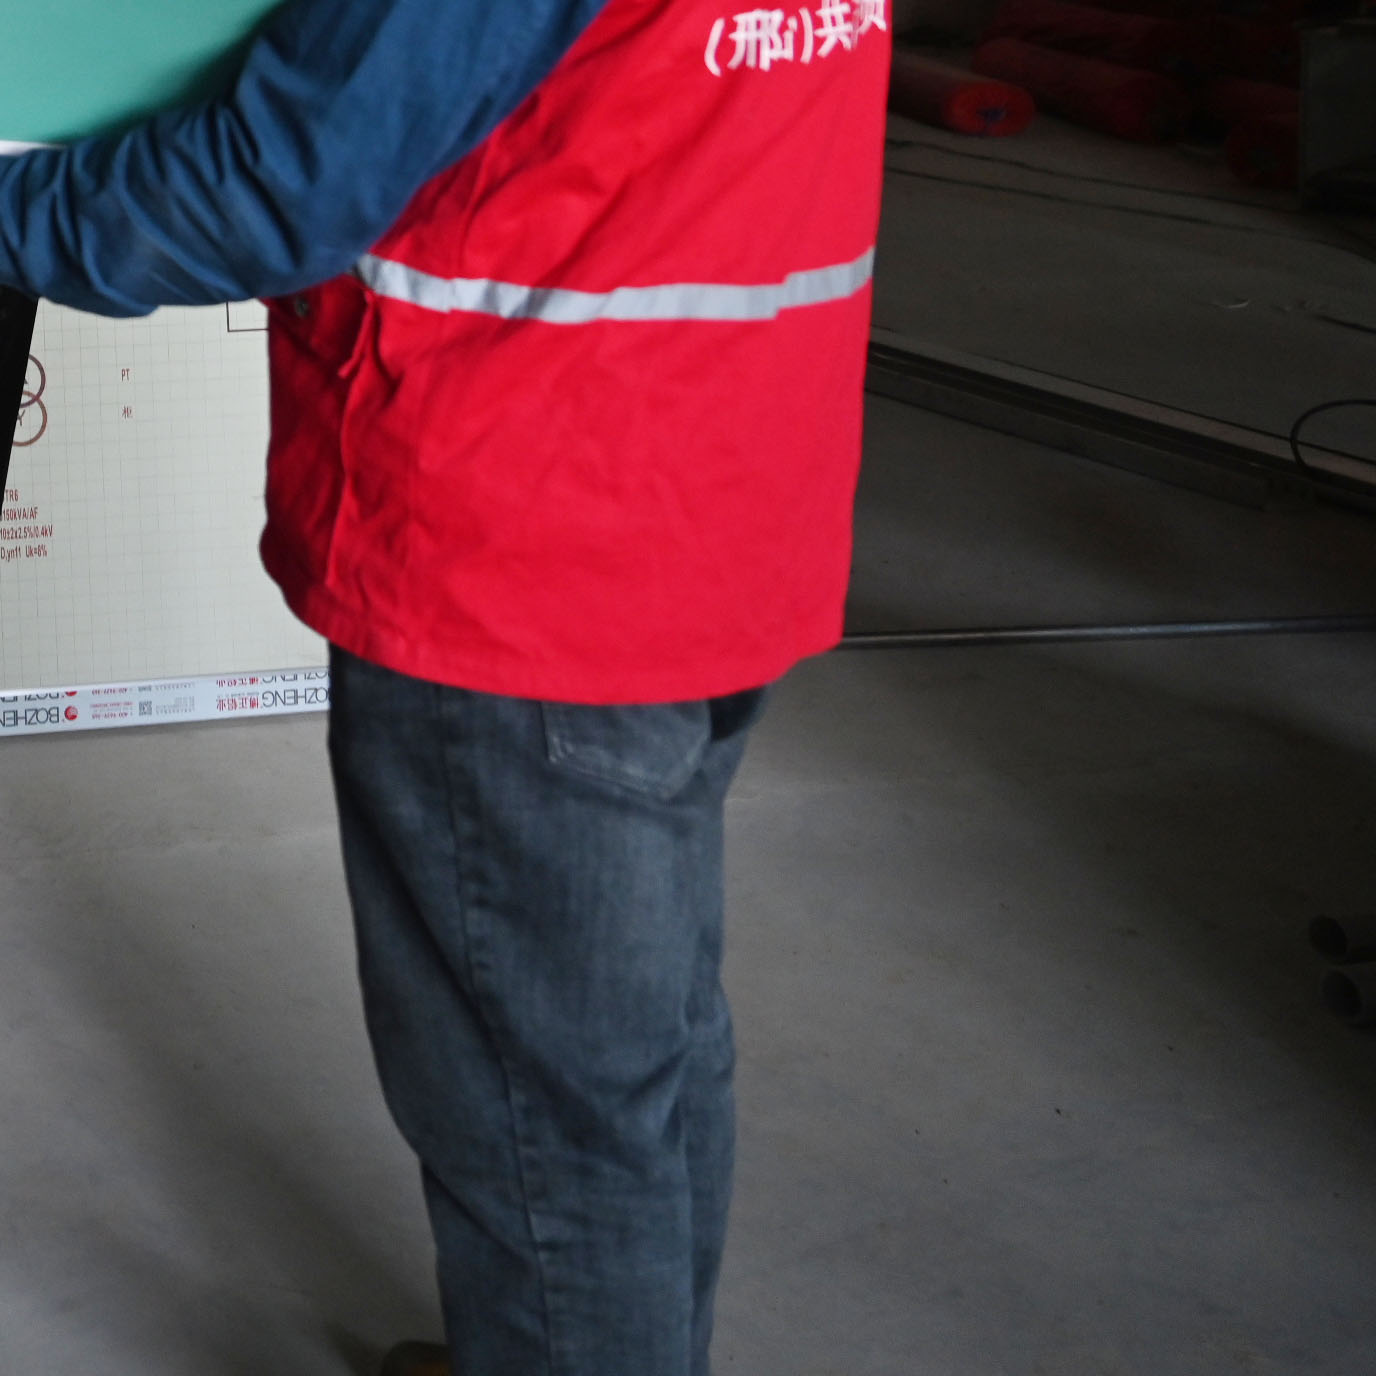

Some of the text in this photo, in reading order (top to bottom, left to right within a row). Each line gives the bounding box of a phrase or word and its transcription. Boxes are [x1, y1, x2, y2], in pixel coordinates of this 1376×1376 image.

[5, 489, 19, 503] TR6
[216, 687, 329, 710] OZHENG 博正铝业
